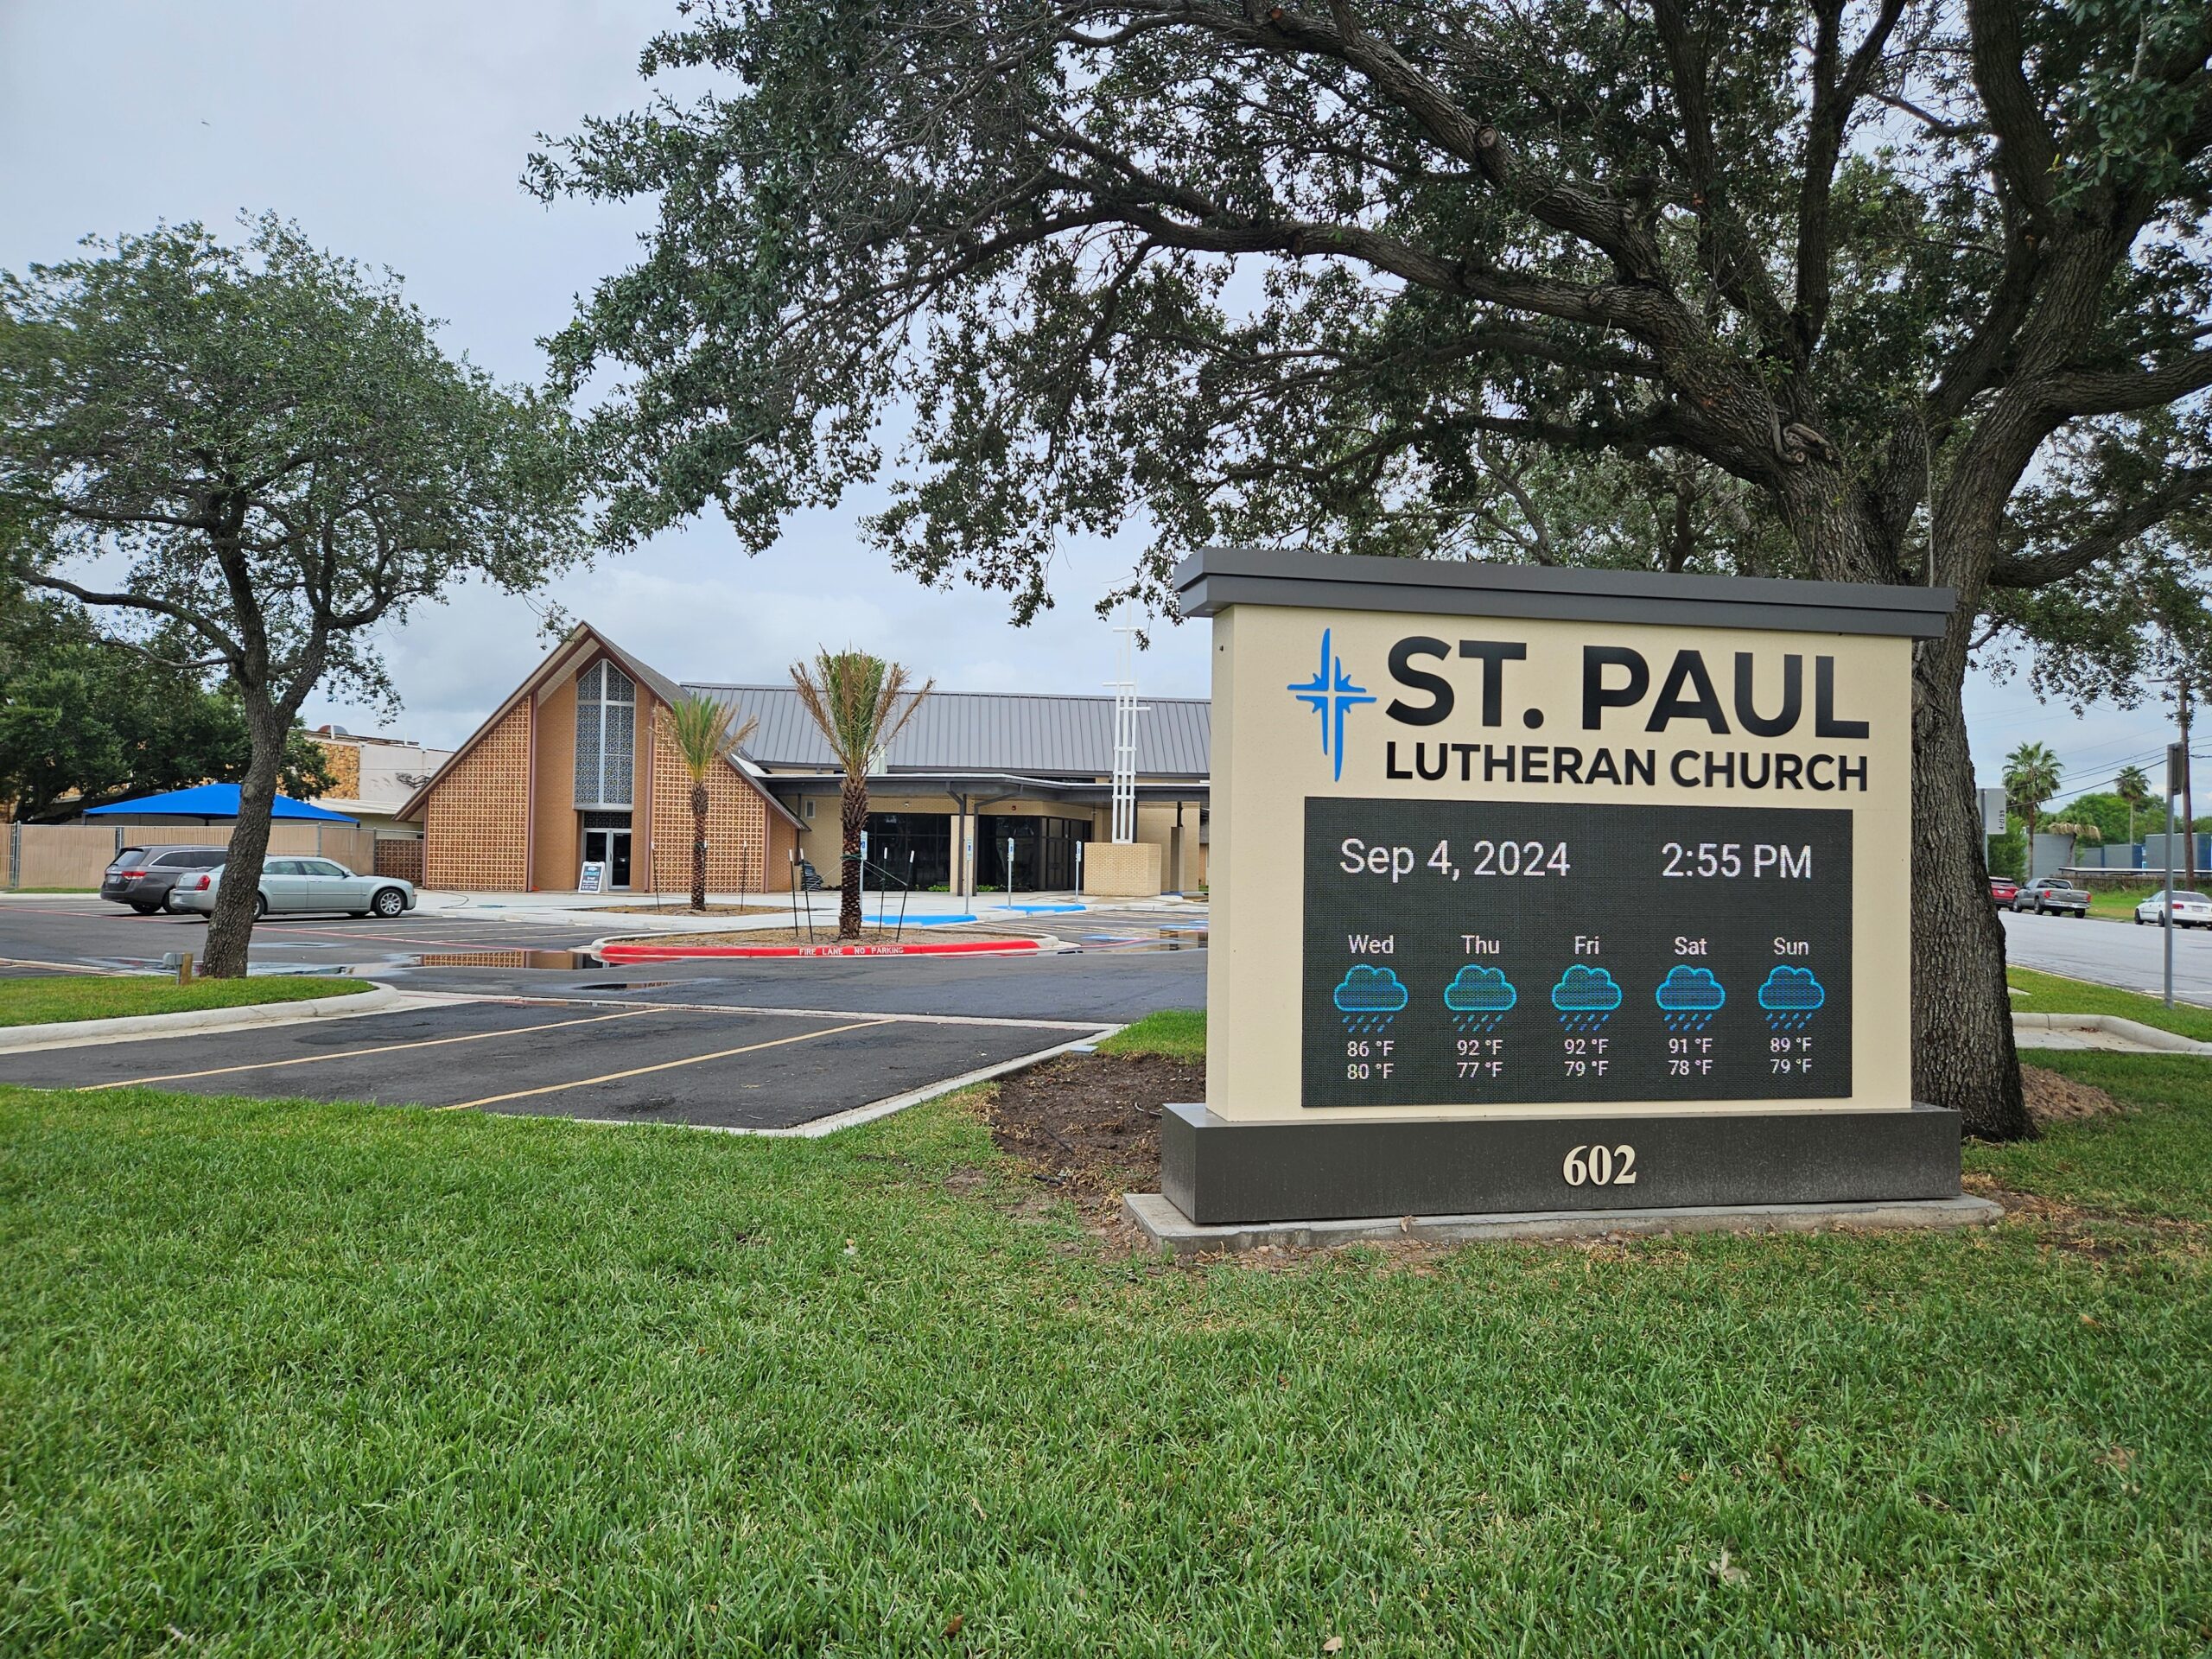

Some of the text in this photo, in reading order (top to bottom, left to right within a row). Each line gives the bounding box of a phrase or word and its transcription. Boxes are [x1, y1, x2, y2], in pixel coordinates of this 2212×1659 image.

[1384, 635, 1871, 740] ST. PAUL
[1385, 741, 1868, 792] LUTHERAN CHURCH
[1339, 838, 1571, 883] Sep 4, 2024
[1662, 842, 1813, 880] 2:55 PM
[1347, 934, 1394, 955] Wed
[1460, 934, 1501, 955] Thu
[1573, 935, 1600, 955] Fri
[1674, 936, 1707, 956] Sat
[1773, 937, 1809, 956] Sun
[1346, 1040, 1370, 1058] 86
[1456, 1039, 1481, 1056] 92
[1563, 1039, 1587, 1055] 92
[1668, 1038, 1689, 1054] 91
[1769, 1037, 1792, 1053] 89
[1346, 1063, 1370, 1080] 80
[1456, 1062, 1480, 1078] 77
[1563, 1060, 1587, 1077] 79
[1668, 1059, 1690, 1076] 78
[1769, 1058, 1792, 1074] 79
[1561, 1144, 1638, 1186] 602
